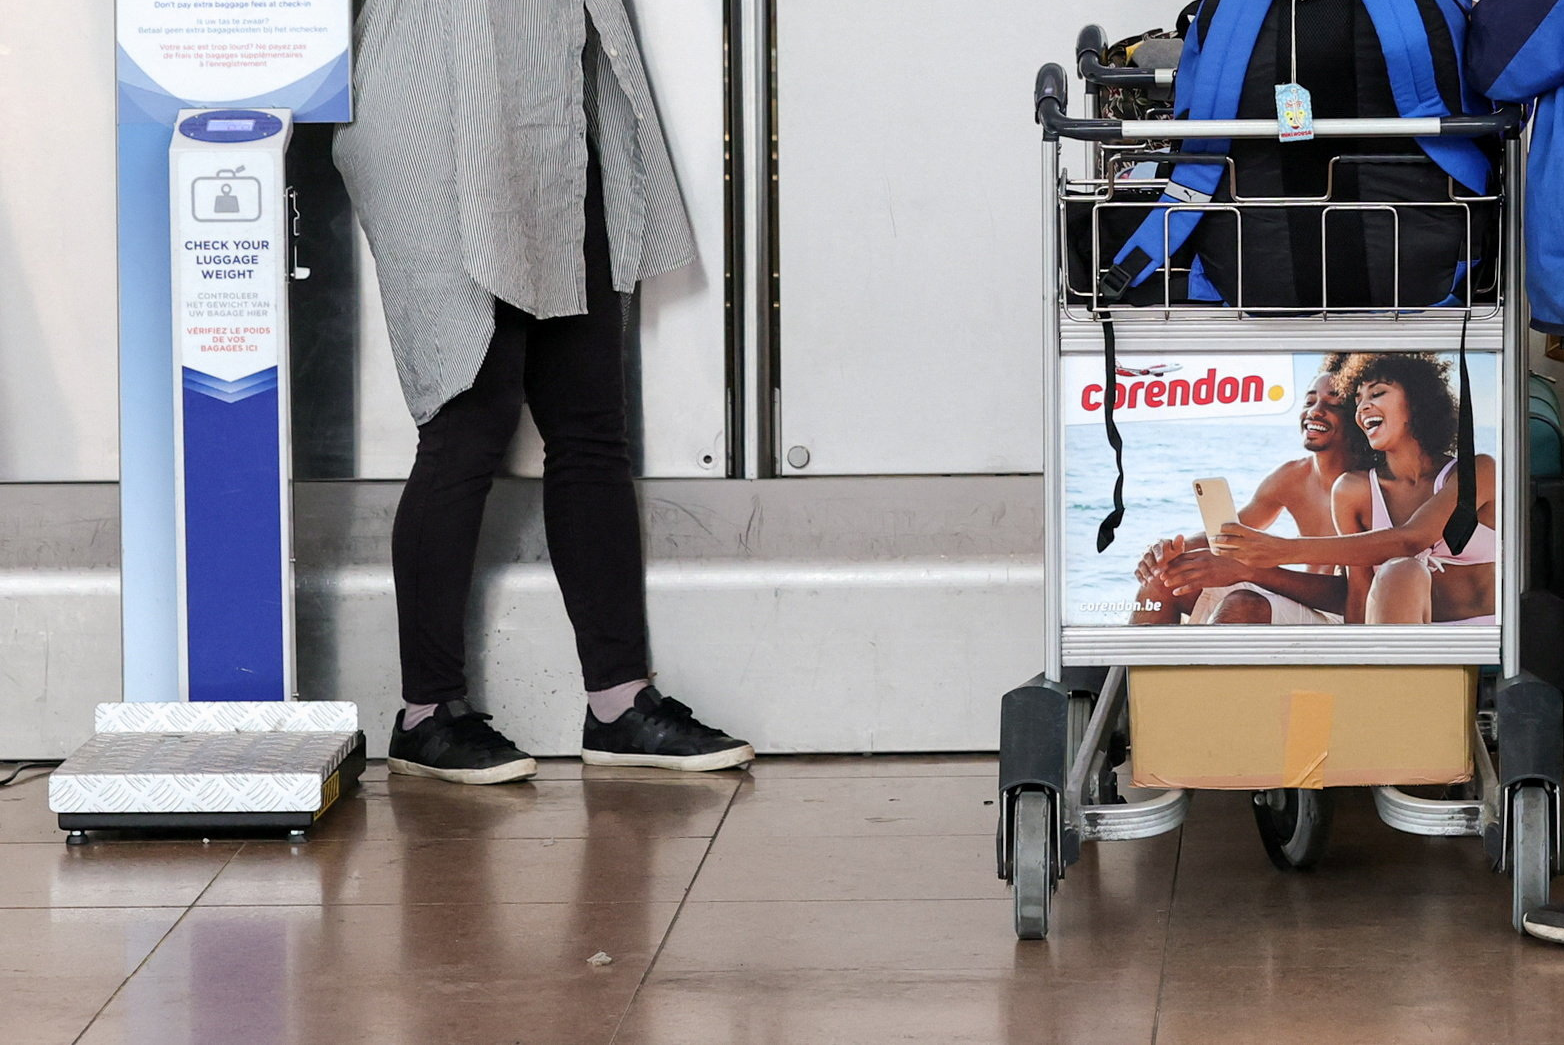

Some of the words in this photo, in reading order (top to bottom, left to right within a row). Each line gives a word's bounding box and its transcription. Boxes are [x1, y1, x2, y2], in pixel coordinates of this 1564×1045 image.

[185, 240, 229, 250] CHECK
[234, 240, 270, 250] YOUR
[196, 255, 259, 265] LUGGAGE
[201, 269, 254, 279] WEIGHT
[197, 292, 258, 300] CONTROLEER
[186, 301, 203, 309] HET
[206, 301, 248, 309] GEWICHT
[187, 326, 227, 335] VÉRIFIEZ
[231, 327, 240, 335] LE
[246, 344, 258, 352] ICI
[1080, 598, 1162, 612] corendon.be
